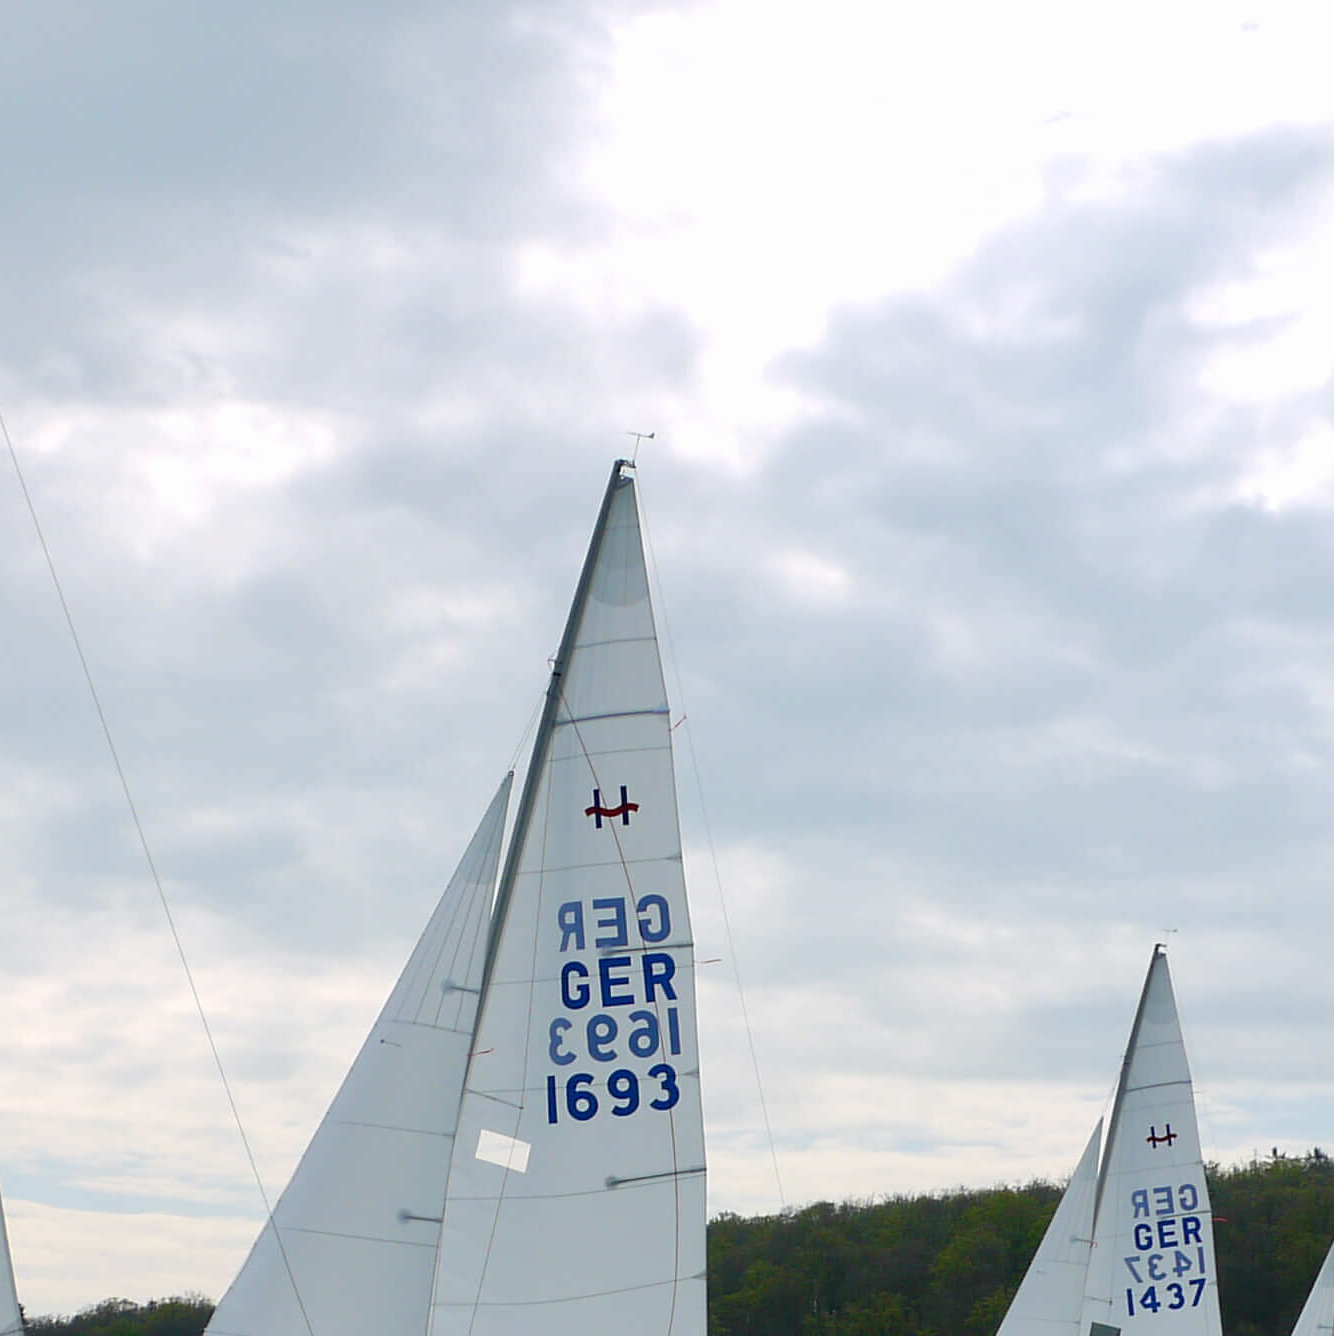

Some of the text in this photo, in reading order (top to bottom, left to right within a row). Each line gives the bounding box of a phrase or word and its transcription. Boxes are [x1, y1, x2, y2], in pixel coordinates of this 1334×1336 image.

[561, 953, 677, 1010] GER
[547, 1063, 679, 1124] 1693
[1134, 1216, 1202, 1251] GER
[1126, 1278, 1206, 1316] 1437
